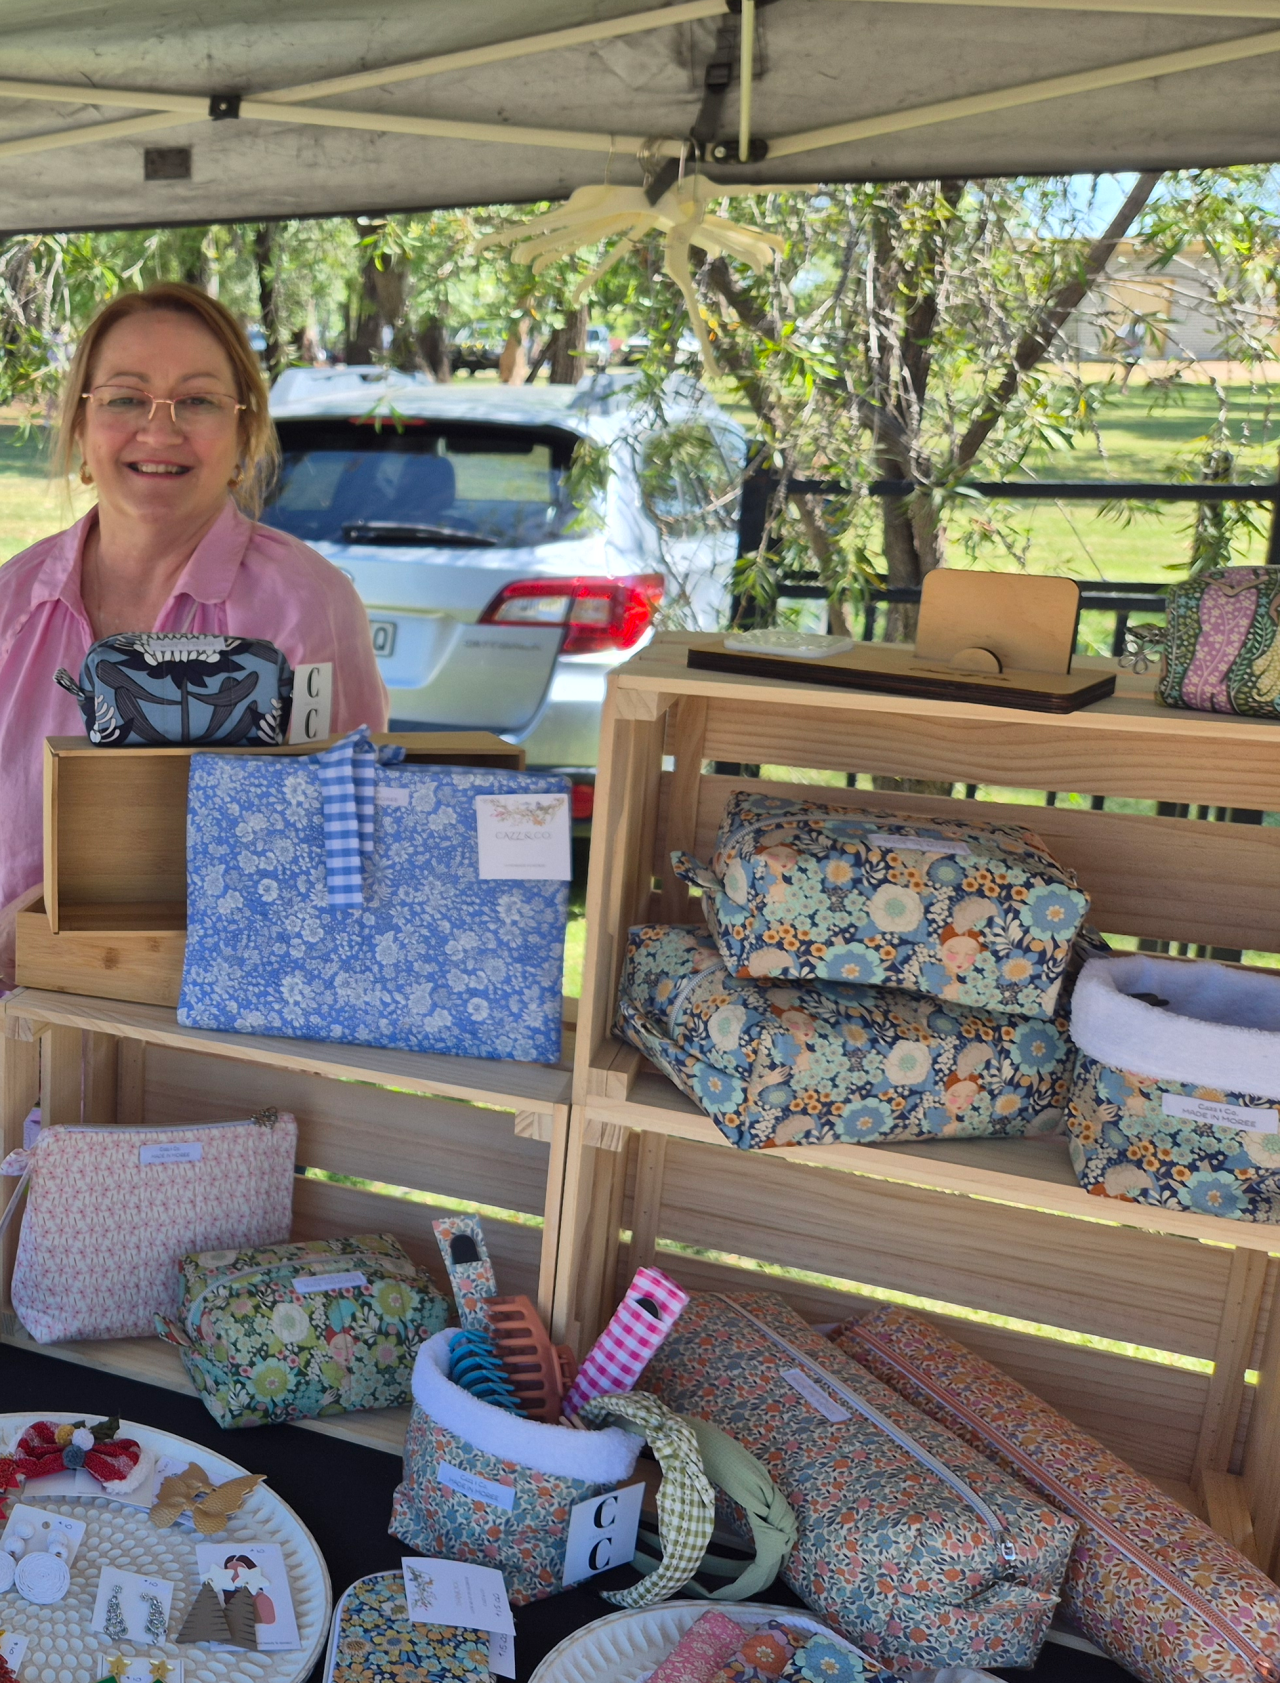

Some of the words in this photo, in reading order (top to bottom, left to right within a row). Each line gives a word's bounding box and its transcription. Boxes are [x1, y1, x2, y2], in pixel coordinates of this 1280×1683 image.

[307, 667, 320, 698] C
[304, 708, 318, 739] C
[1182, 1108, 1208, 1118] MADE
[1221, 1116, 1257, 1128] MOREE
[1198, 1103, 1218, 1112] Cazz
[1224, 1108, 1239, 1117] Co.
[448, 1476, 466, 1490] MADE
[594, 1496, 618, 1528] C
[588, 1537, 612, 1571] C
